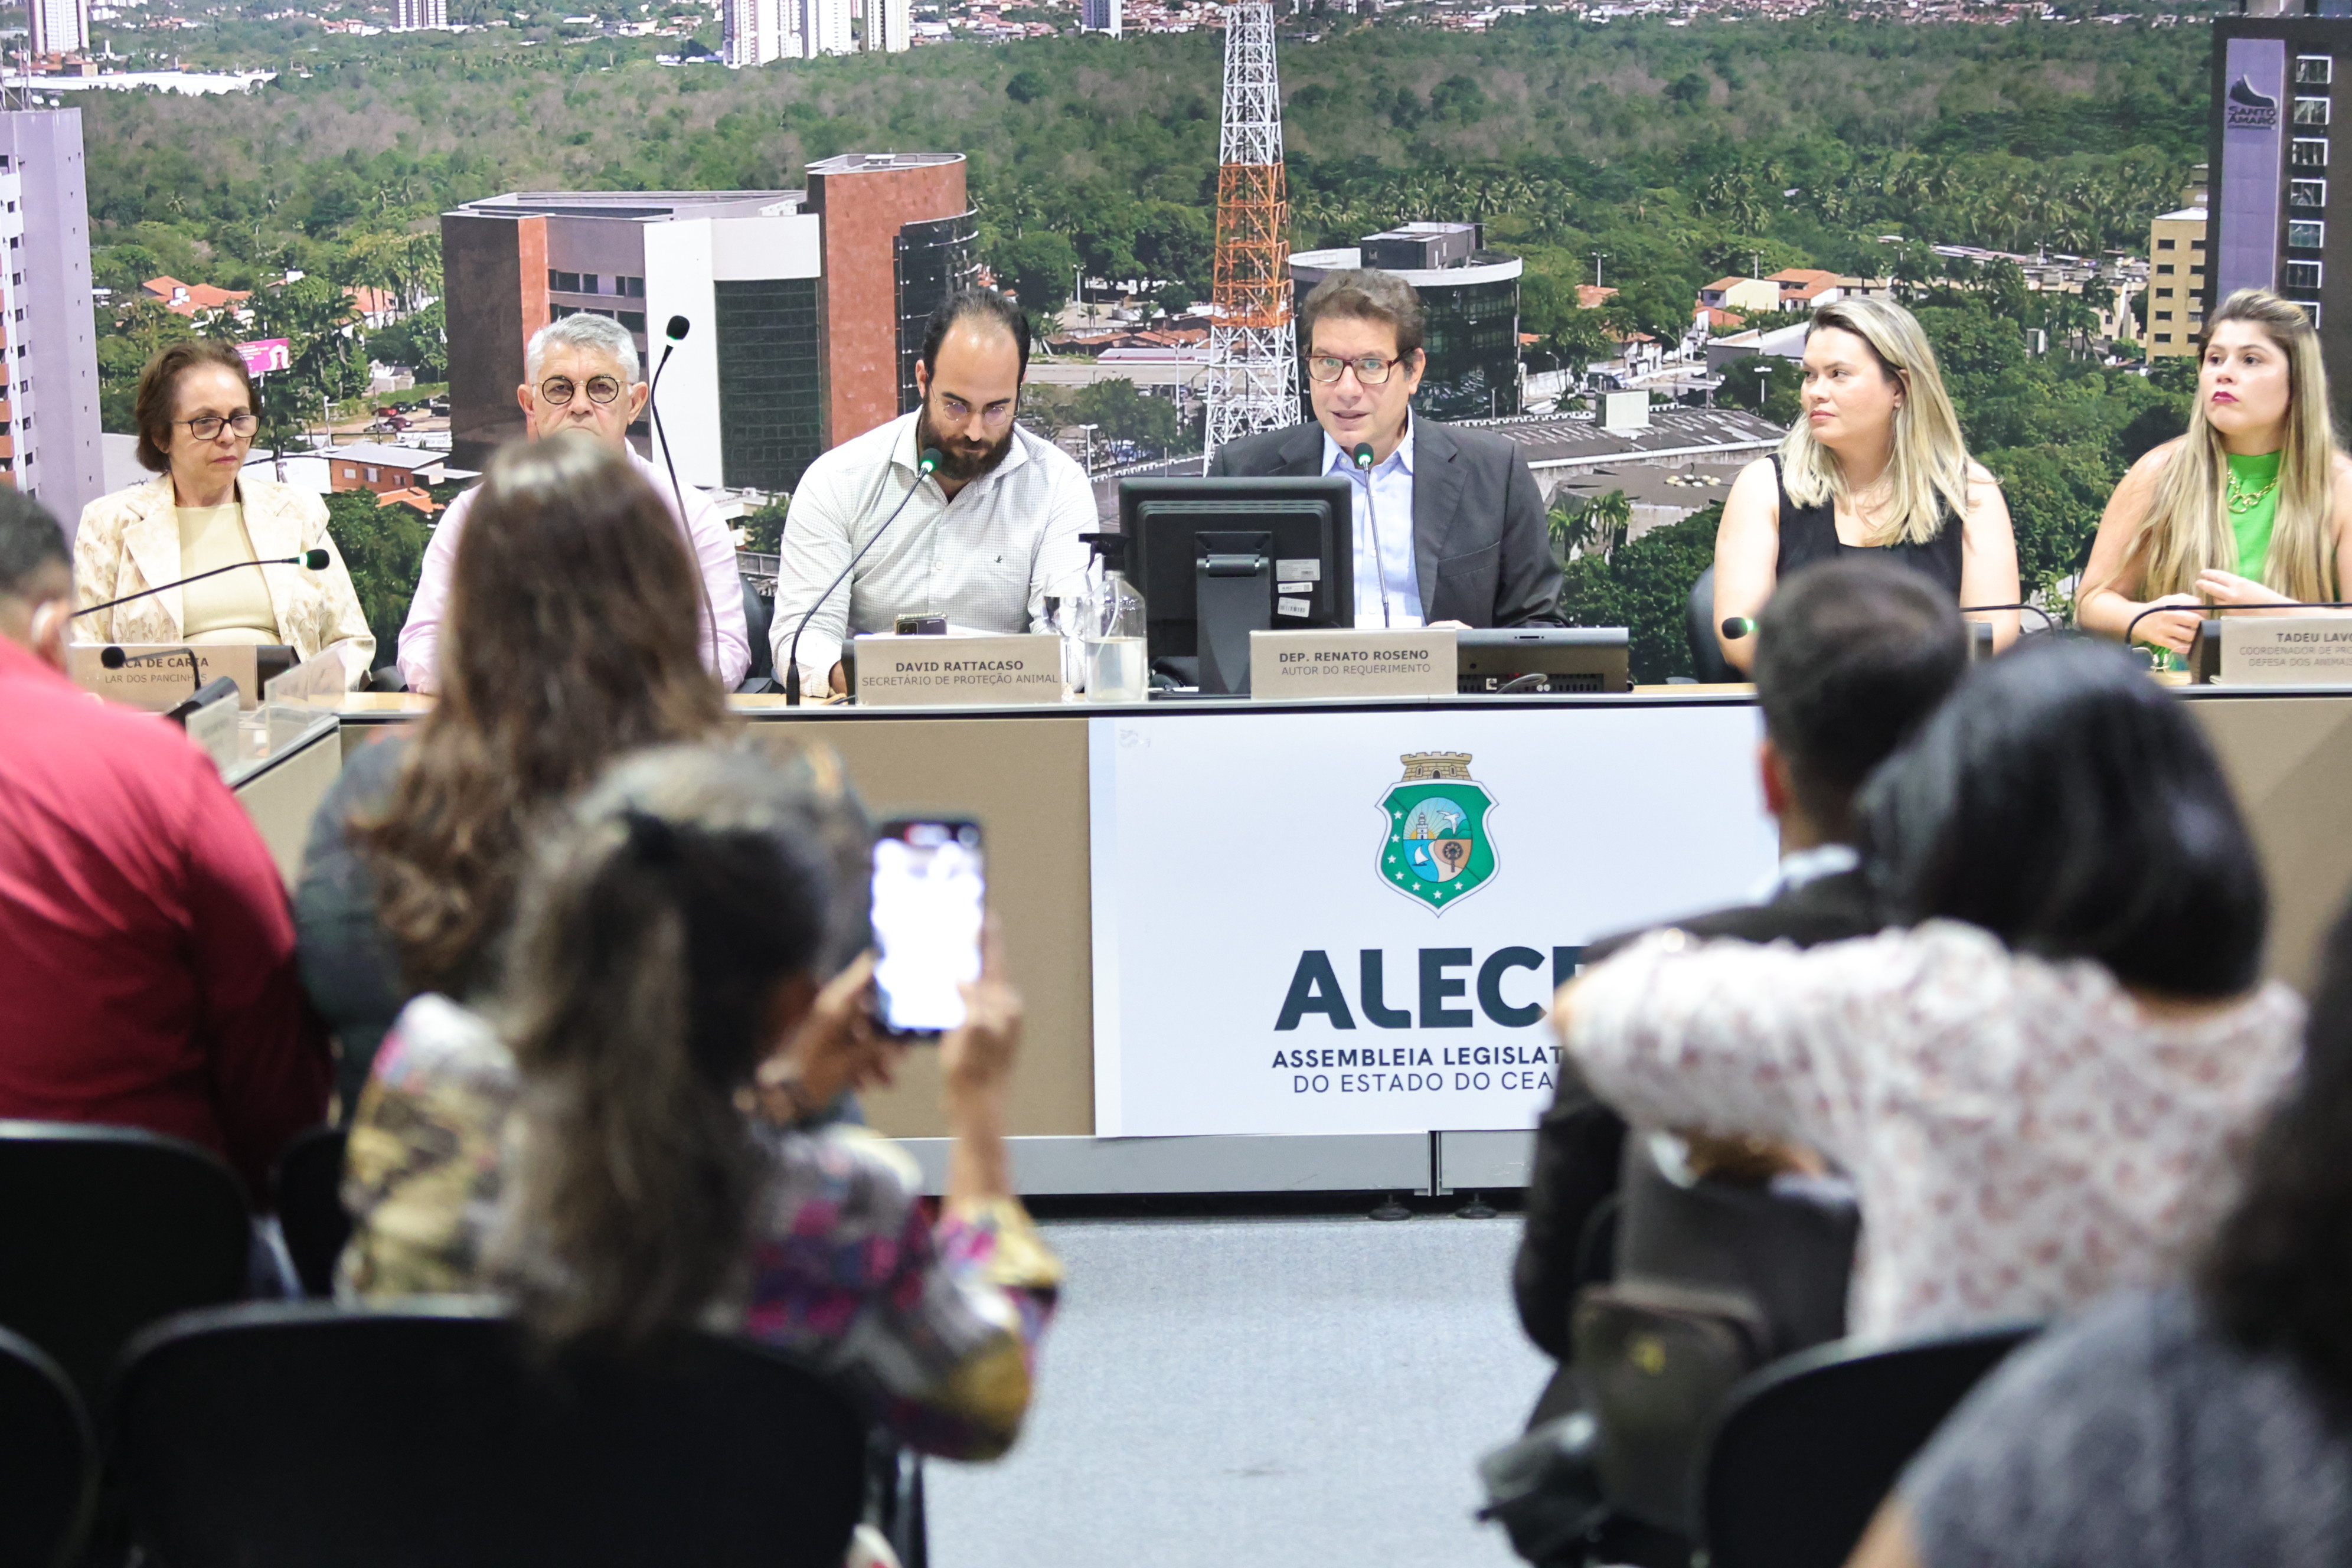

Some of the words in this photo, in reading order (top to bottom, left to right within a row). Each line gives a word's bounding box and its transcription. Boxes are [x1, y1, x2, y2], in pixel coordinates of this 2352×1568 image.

[2277, 633, 2320, 642] TADEU
[1280, 653, 1309, 662] DEP.
[1315, 651, 1368, 661] RENATO
[1373, 650, 1429, 661] ROSENO
[2239, 647, 2315, 655] COORDENADOR
[148, 658, 163, 668] DE
[896, 662, 939, 672] DAVID
[944, 661, 1023, 671] RATTACASO
[2249, 658, 2286, 667] DEFESA
[1282, 666, 1319, 675] AUTOR
[1323, 666, 1339, 675] DO
[1344, 664, 1430, 675] REQUERIMENTO
[106, 675, 123, 684] LAR
[127, 675, 147, 683] DOS
[151, 674, 207, 682] PANCINHS
[862, 674, 931, 686] SECRETÁRIO
[935, 675, 950, 685] DE
[954, 673, 1012, 686] PROTEÇÃO
[1016, 674, 1058, 684] ANIMAL
[1272, 1048, 1433, 1069] ASSEMBLEIA
[1294, 1075, 1329, 1093] DO
[1341, 1073, 1443, 1092] ESTADO
[1456, 1072, 1491, 1091] DO
